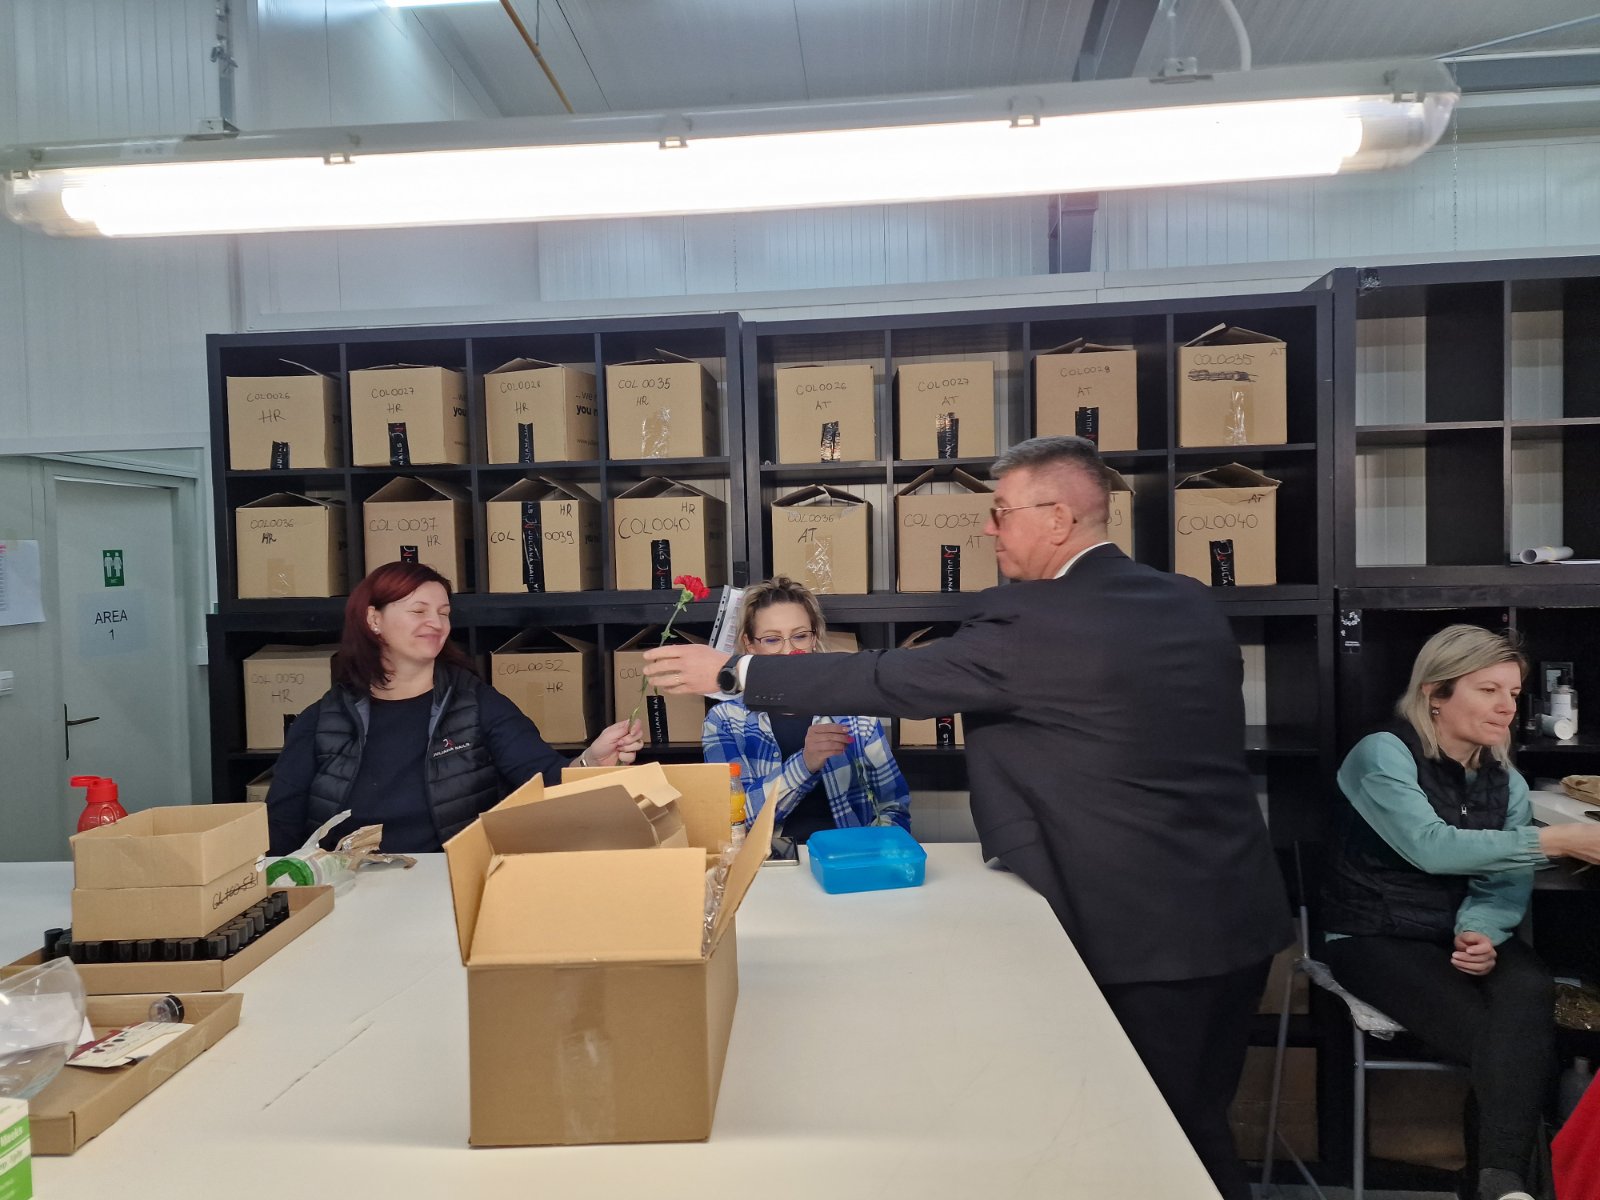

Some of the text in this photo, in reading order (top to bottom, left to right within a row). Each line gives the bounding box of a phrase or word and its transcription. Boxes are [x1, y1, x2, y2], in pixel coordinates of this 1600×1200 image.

[371, 387, 415, 399] COL0027
[258, 408, 288, 423] HR
[386, 403, 404, 415] HR
[515, 401, 529, 415] HR
[559, 503, 574, 518] HR
[680, 501, 696, 515] HR
[618, 517, 691, 540] COL0040
[1177, 513, 1259, 536] COL0040
[426, 535, 442, 548] HR
[490, 530, 516, 545] COL
[544, 530, 575, 545] 0039
[797, 527, 818, 544] AT
[965, 534, 983, 549] AT
[94, 609, 128, 625] AREA
[108, 628, 115, 641] 1
[546, 681, 563, 693] HR
[271, 689, 294, 704] HR
